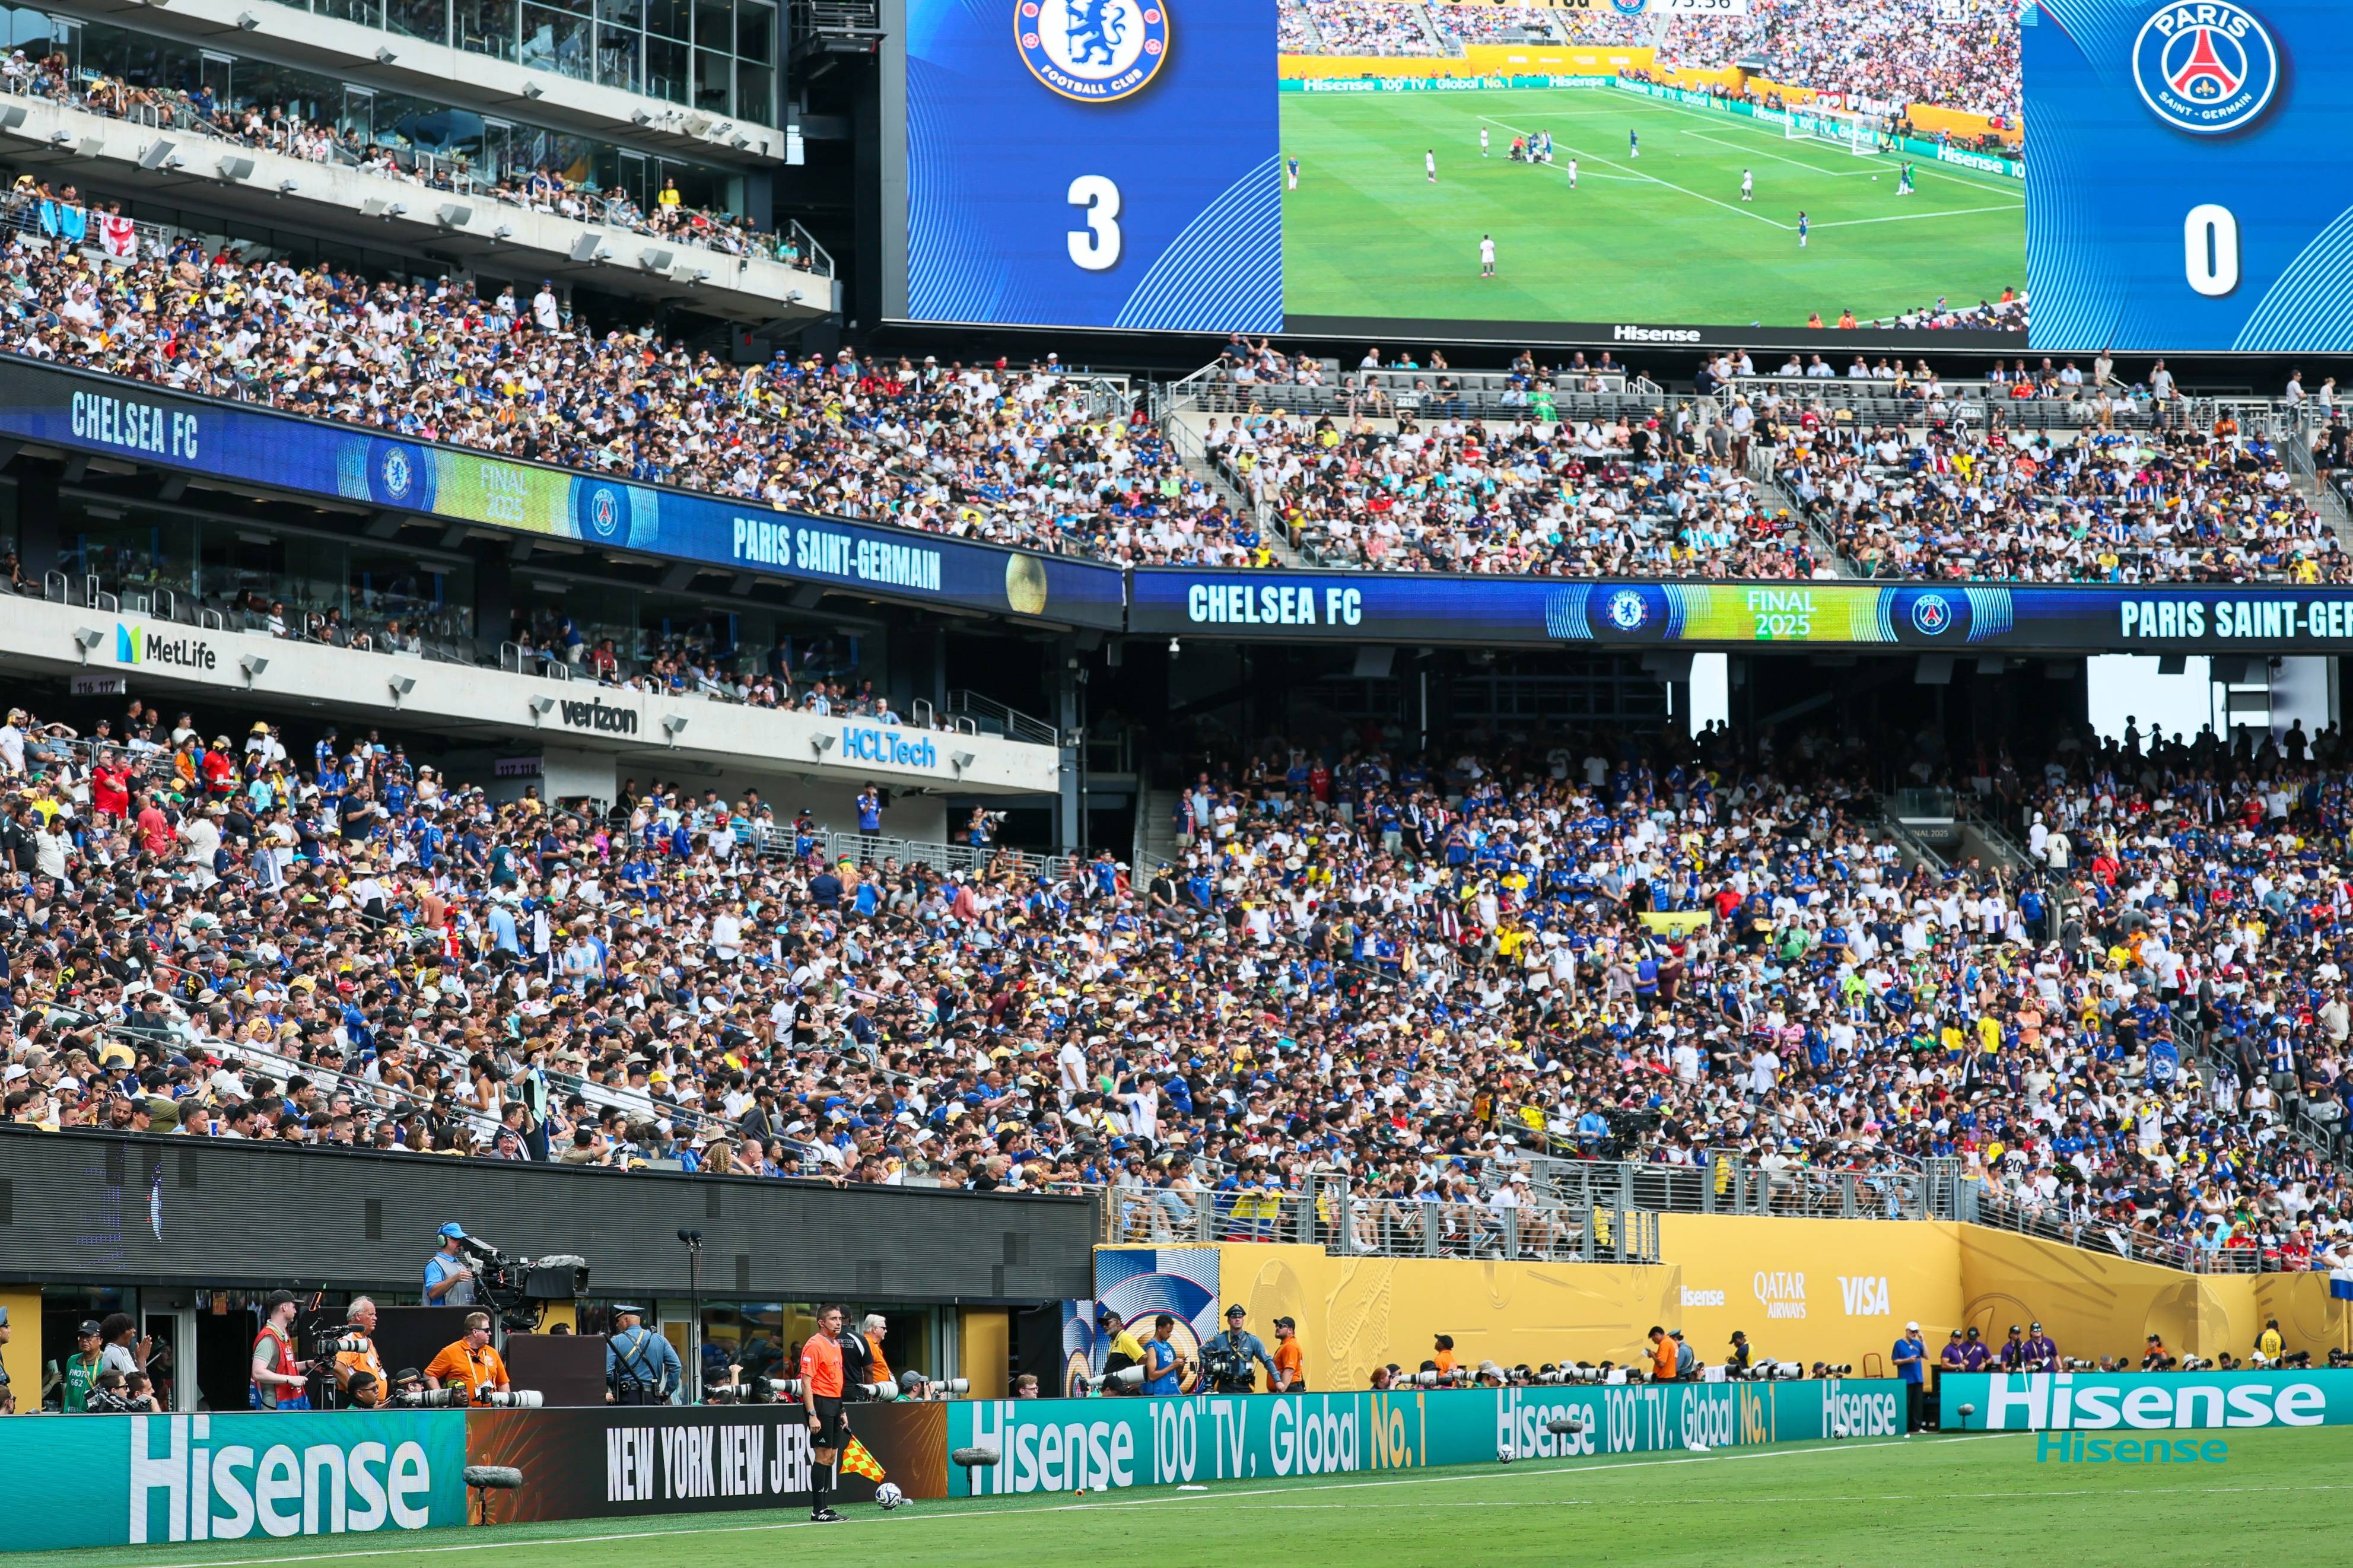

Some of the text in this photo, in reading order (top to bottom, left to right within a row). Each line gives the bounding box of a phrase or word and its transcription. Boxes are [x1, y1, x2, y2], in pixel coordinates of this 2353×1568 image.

[2154, 5, 2250, 38] PARIS
[1040, 65, 1143, 94] FOOTBALL CLUB
[1304, 79, 1375, 91] Hisense
[1436, 78, 1478, 90] Global
[1549, 76, 1606, 87] Hisense
[2158, 91, 2193, 116] SAINT
[2202, 92, 2253, 120] GERMAIN
[1937, 148, 2005, 174] Hisense
[1067, 175, 1120, 270] 3
[2185, 203, 2239, 295] 0
[1614, 325, 1701, 342] Hisense
[71, 390, 198, 460] CHELSEA FC
[481, 463, 528, 496] FINAL
[486, 492, 524, 522] 2025
[733, 517, 941, 591] PARIS SAINT-GERMAIN
[1188, 584, 1362, 626] CHELSEA FC
[1747, 590, 1817, 613] FINAL
[1756, 613, 1811, 636] 2025
[2121, 601, 2206, 638] PARIS
[146, 634, 216, 669] MetLife
[77, 680, 116, 694] 116 117
[560, 696, 638, 734] verizon
[842, 727, 936, 768] HCLTech
[500, 764, 536, 775] 117 118
[1753, 1271, 1805, 1305] QATAR
[1837, 1276, 1890, 1315] VISA
[1767, 1302, 1806, 1319] AIRWAYS
[69, 1368, 90, 1378] PHOTO
[71, 1378, 83, 1387] 662
[1823, 1379, 1897, 1439] Hisense
[1986, 1373, 2326, 1430] Hisense
[1496, 1388, 1595, 1459] Hisense
[1681, 1383, 1734, 1449] Global
[1740, 1383, 1767, 1445] No.
[1769, 1383, 1775, 1443] 1
[972, 1401, 1134, 1496] Hisense
[1270, 1394, 1360, 1476] Global
[1371, 1392, 1413, 1470] No.
[1416, 1392, 1426, 1467] 1
[129, 1414, 430, 1544] Hisense
[607, 1427, 654, 1502] NEW
[661, 1426, 716, 1499] YORK
[720, 1425, 764, 1497] NEW
